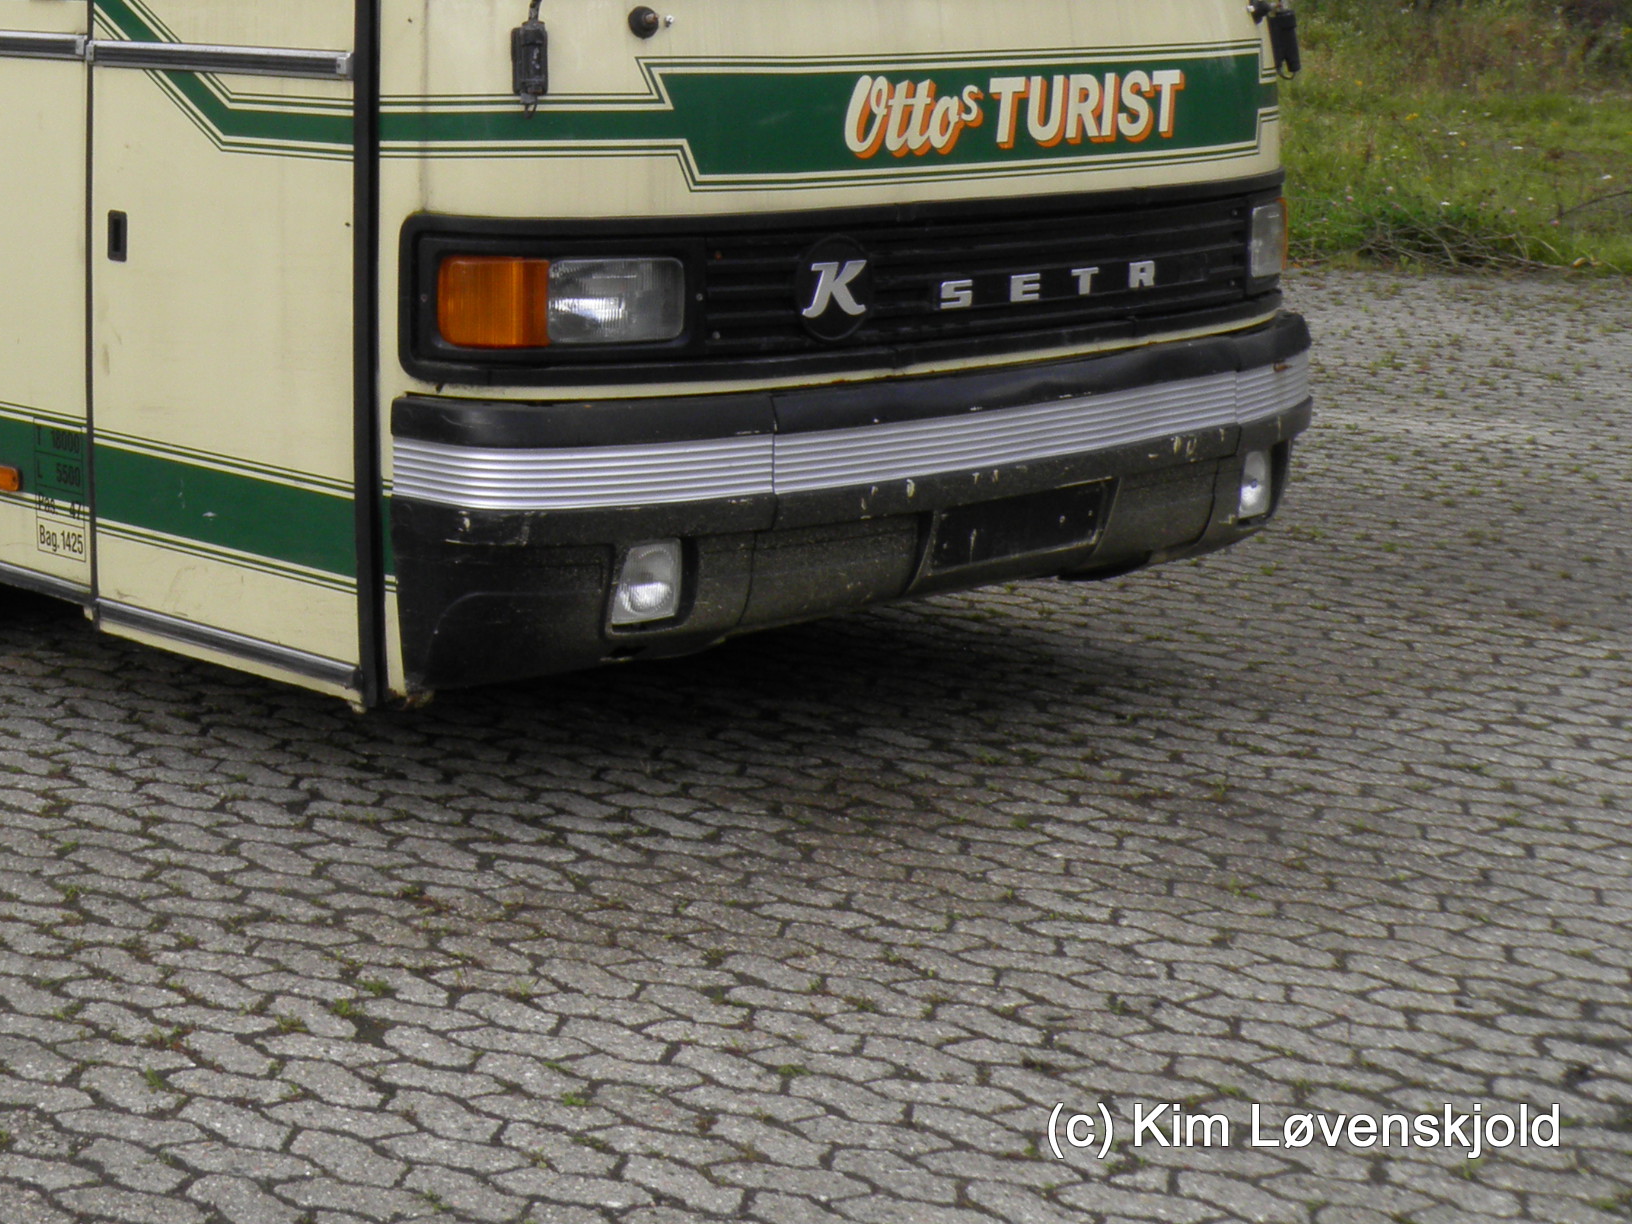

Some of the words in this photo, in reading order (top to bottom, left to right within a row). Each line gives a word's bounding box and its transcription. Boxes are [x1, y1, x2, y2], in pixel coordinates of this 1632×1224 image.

[989, 69, 1184, 149] TURIST
[39, 524, 60, 552] Bag.
[61, 530, 84, 555] 1425
